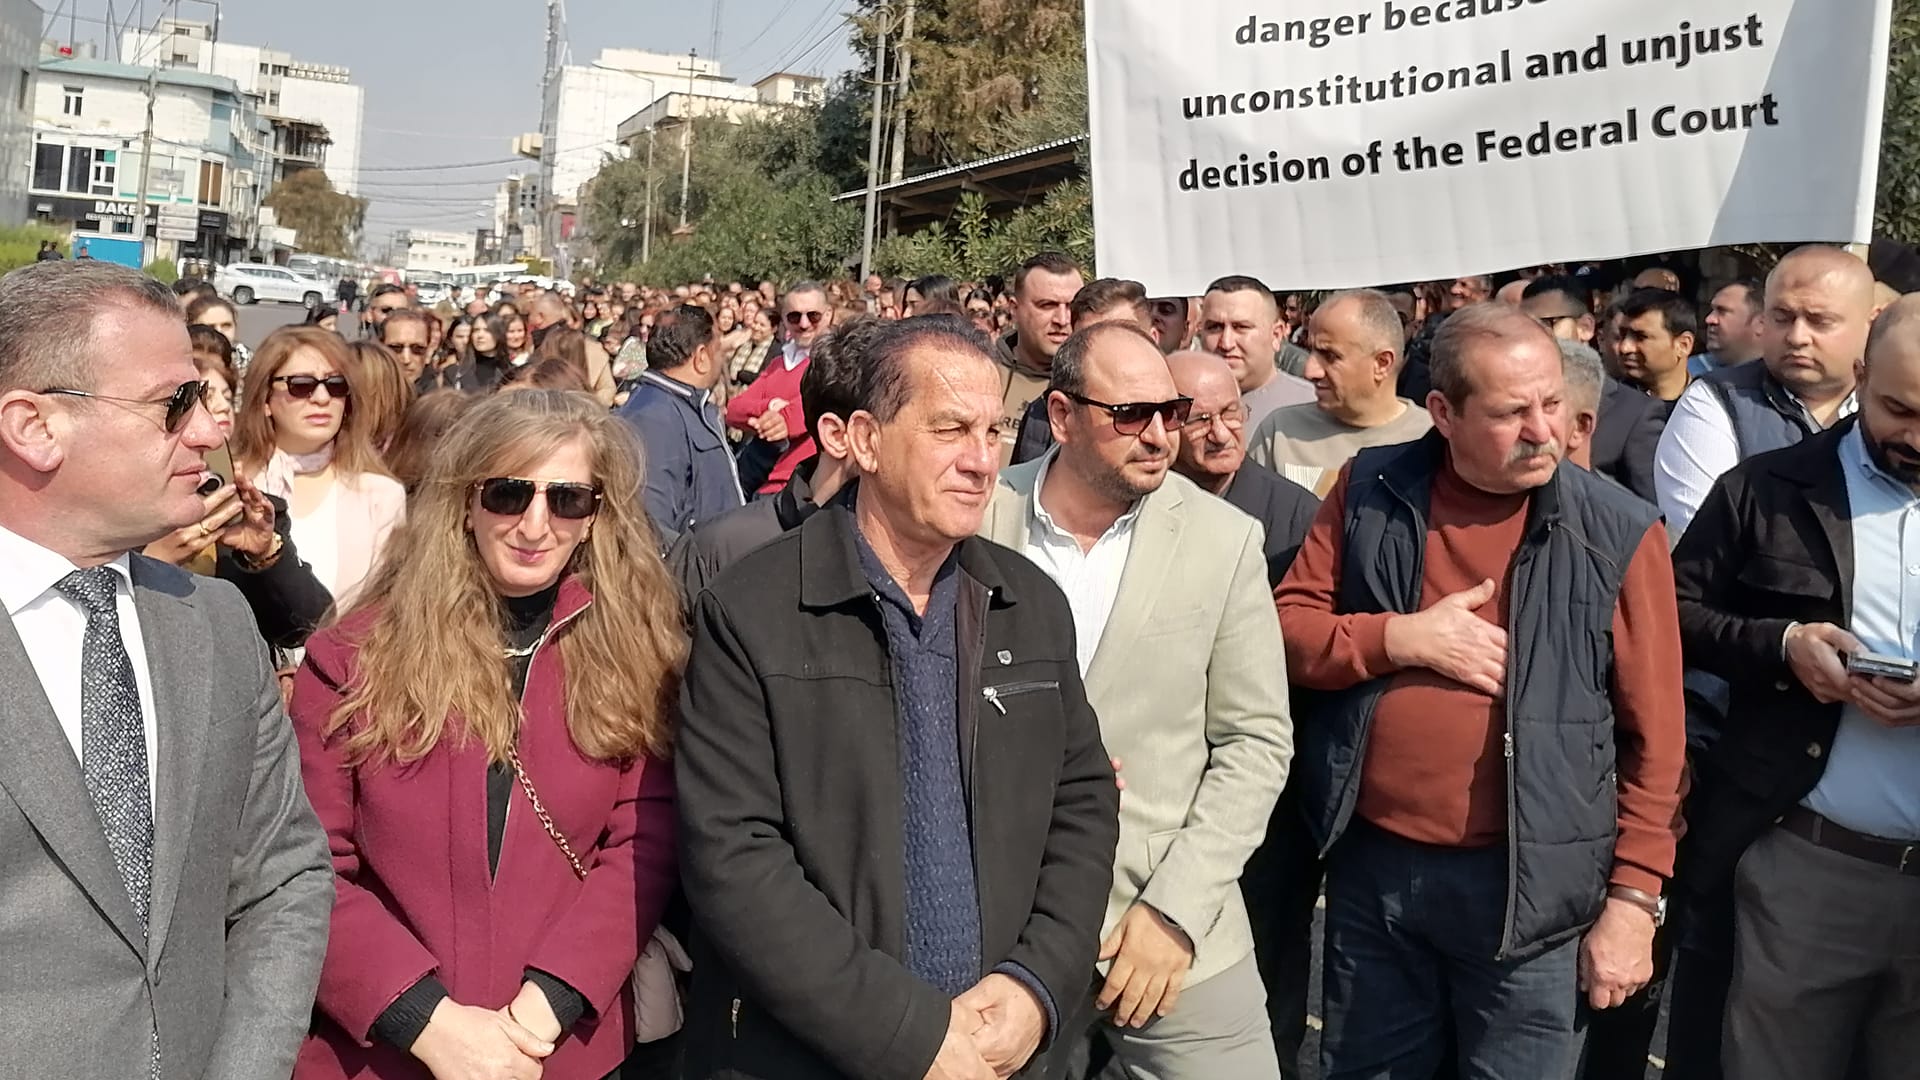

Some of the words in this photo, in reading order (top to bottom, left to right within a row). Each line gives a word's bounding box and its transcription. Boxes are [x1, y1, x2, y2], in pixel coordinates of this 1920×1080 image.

[1182, 49, 1512, 121] unconstitutional
[1525, 34, 1608, 79] and
[1622, 13, 1763, 69] unjust
[1235, 14, 1372, 48] danger
[1384, 0, 1546, 31] becau
[1179, 140, 1330, 192] decision
[1341, 140, 1382, 176] of
[1392, 133, 1464, 171] the
[1475, 109, 1638, 163] Federal
[1651, 92, 1780, 137] Court
